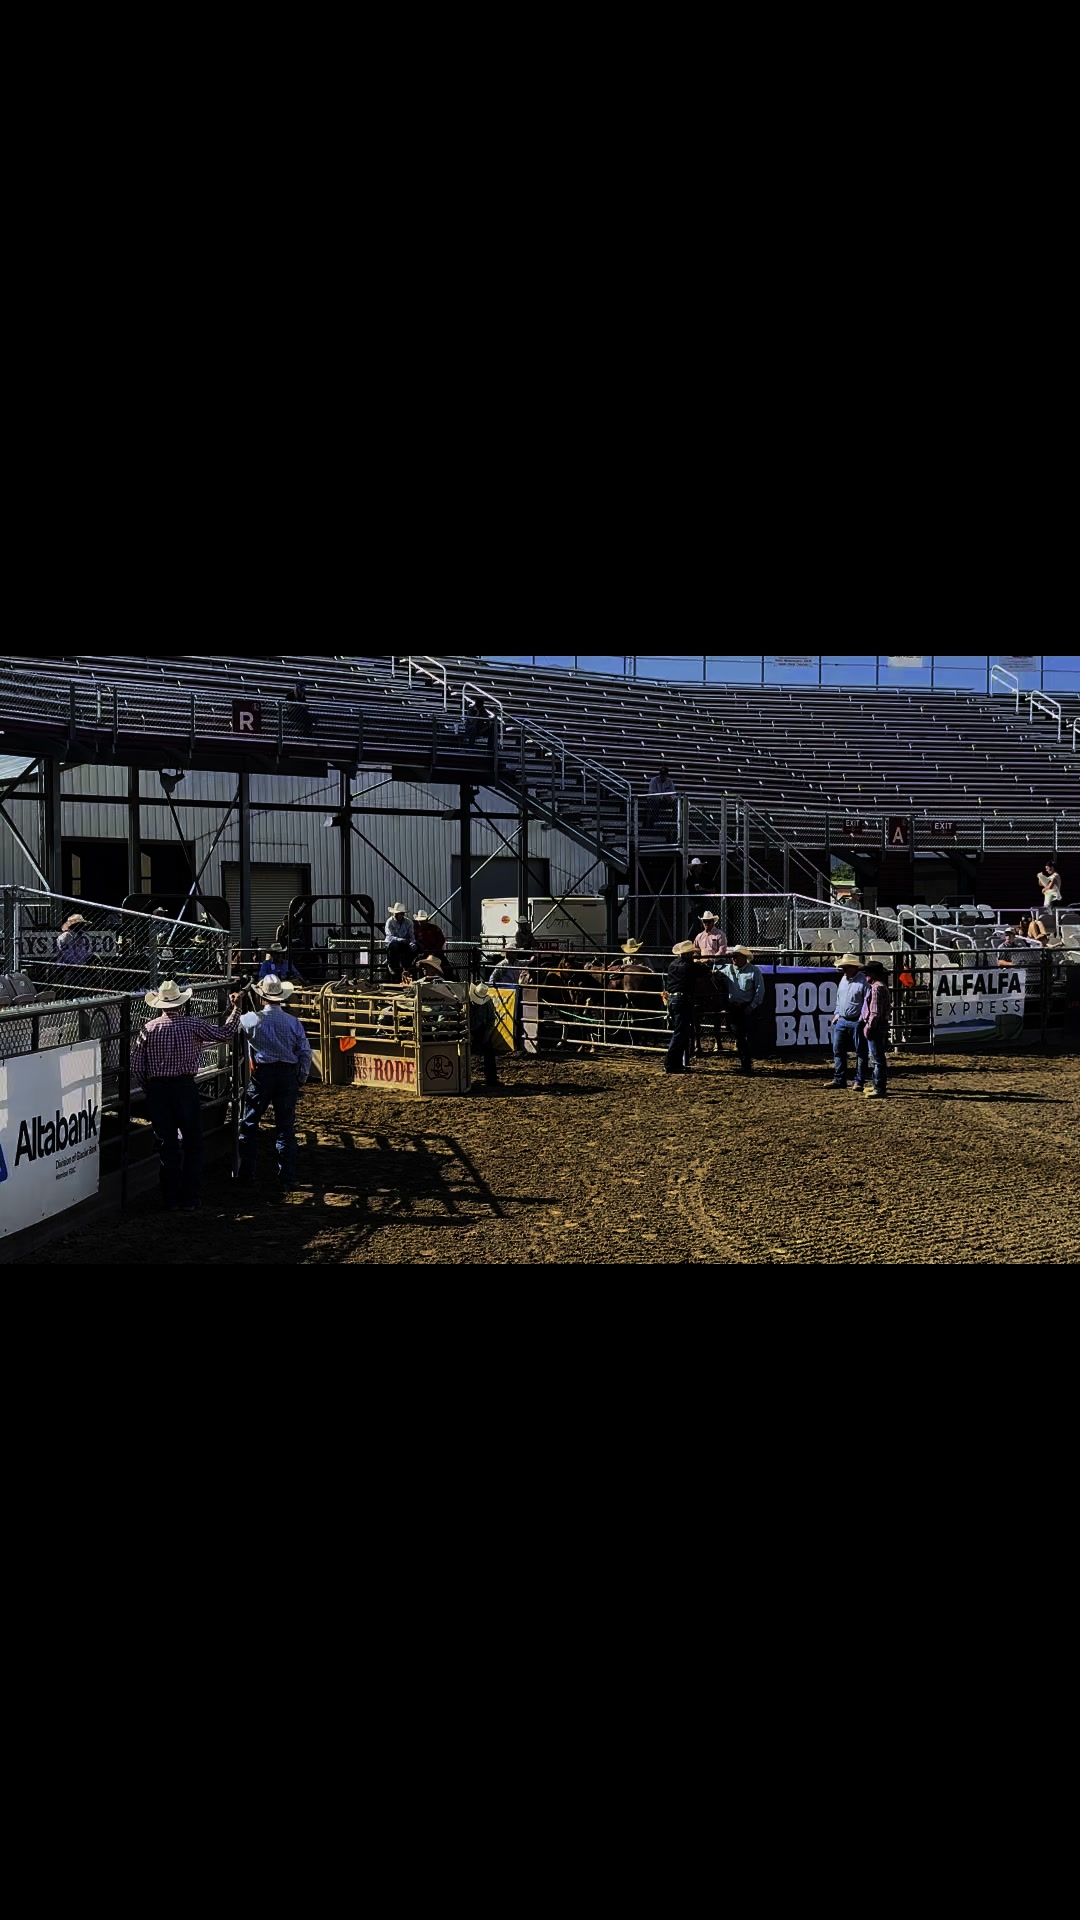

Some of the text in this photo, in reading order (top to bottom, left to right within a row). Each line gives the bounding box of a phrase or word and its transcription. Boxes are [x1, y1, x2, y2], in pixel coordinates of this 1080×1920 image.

[240, 711, 254, 731] R
[845, 819, 860, 827] EXIT
[934, 822, 954, 830] EXIT
[892, 826, 905, 844] A
[936, 972, 1022, 996] ALFALFA
[936, 999, 1021, 1016] EXPRESS
[347, 1056, 367, 1066] FIESTA
[347, 1066, 368, 1079] DAYS
[14, 1099, 98, 1167] Altabank
